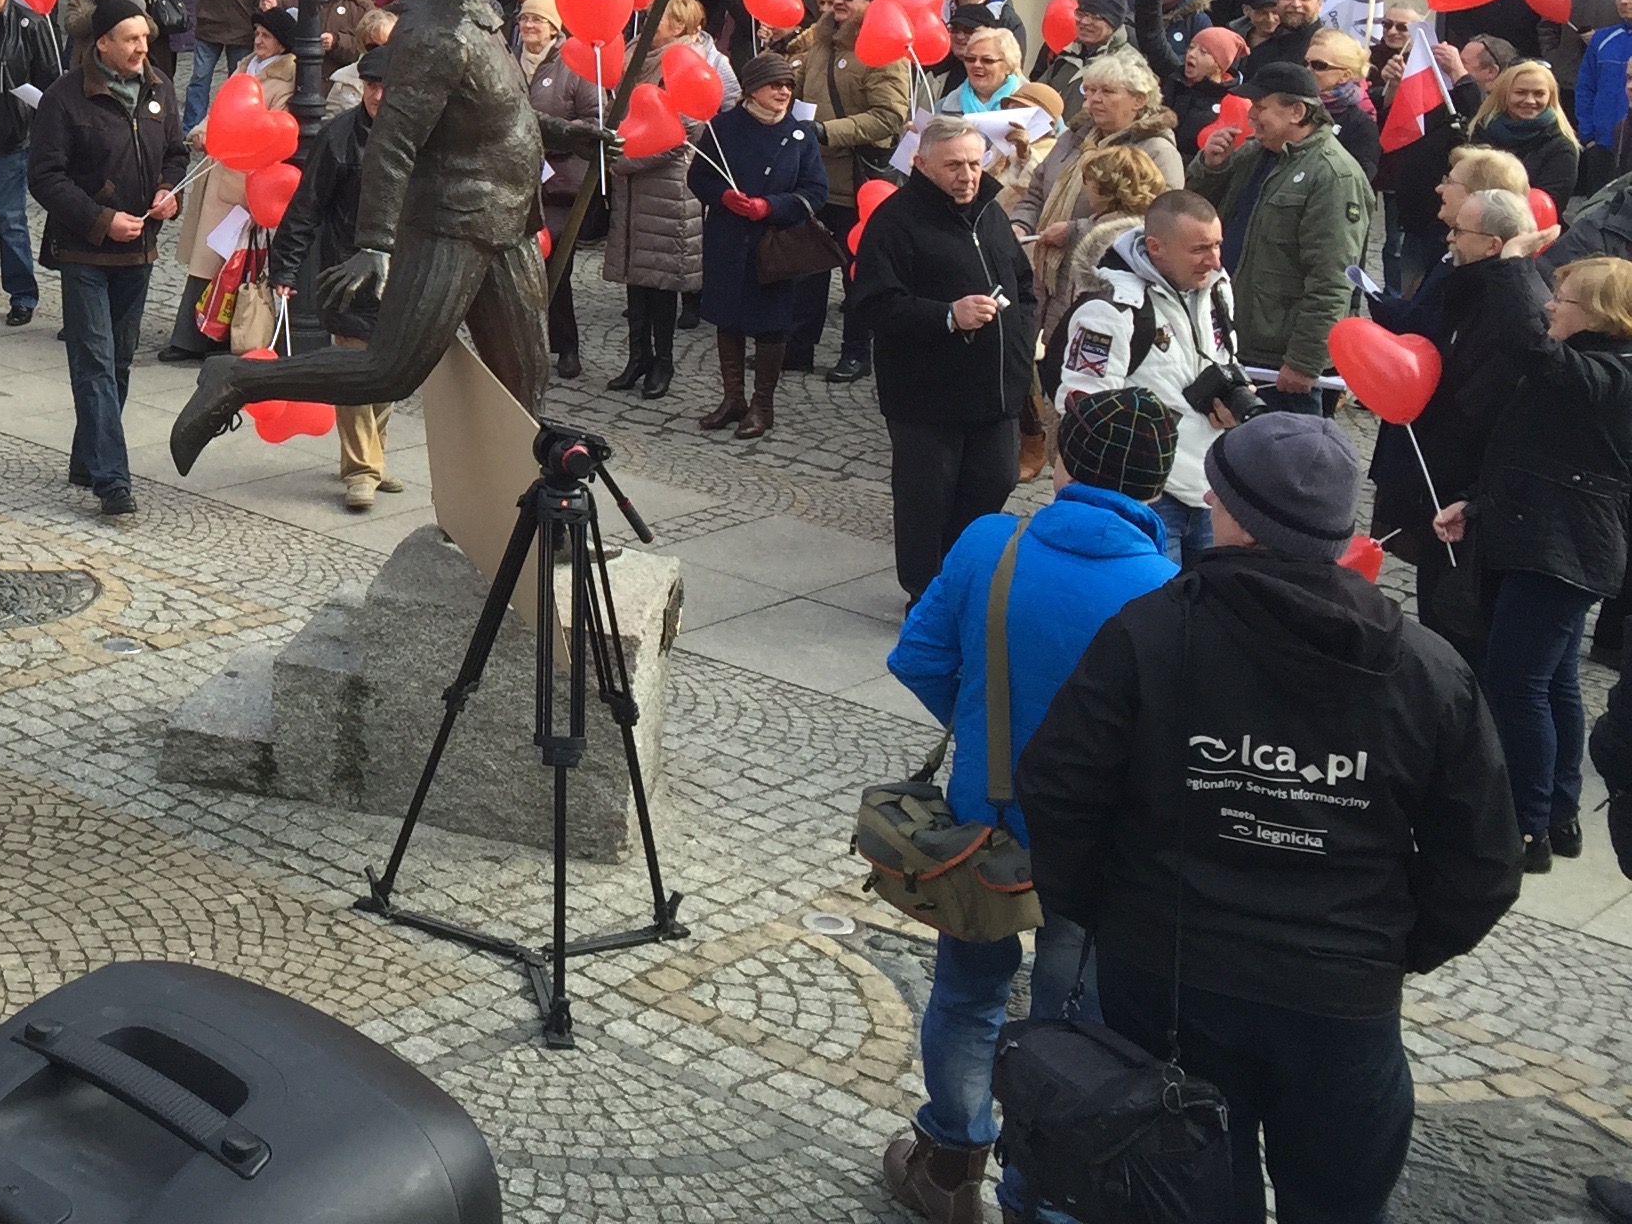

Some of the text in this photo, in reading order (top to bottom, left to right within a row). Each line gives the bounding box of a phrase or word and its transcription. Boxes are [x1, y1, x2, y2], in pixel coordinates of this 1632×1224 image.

[1186, 777, 1370, 809] egionalny Serwis Informacyjny
[1220, 807, 1257, 821] gazeta
[1256, 826, 1324, 848] legnicka
